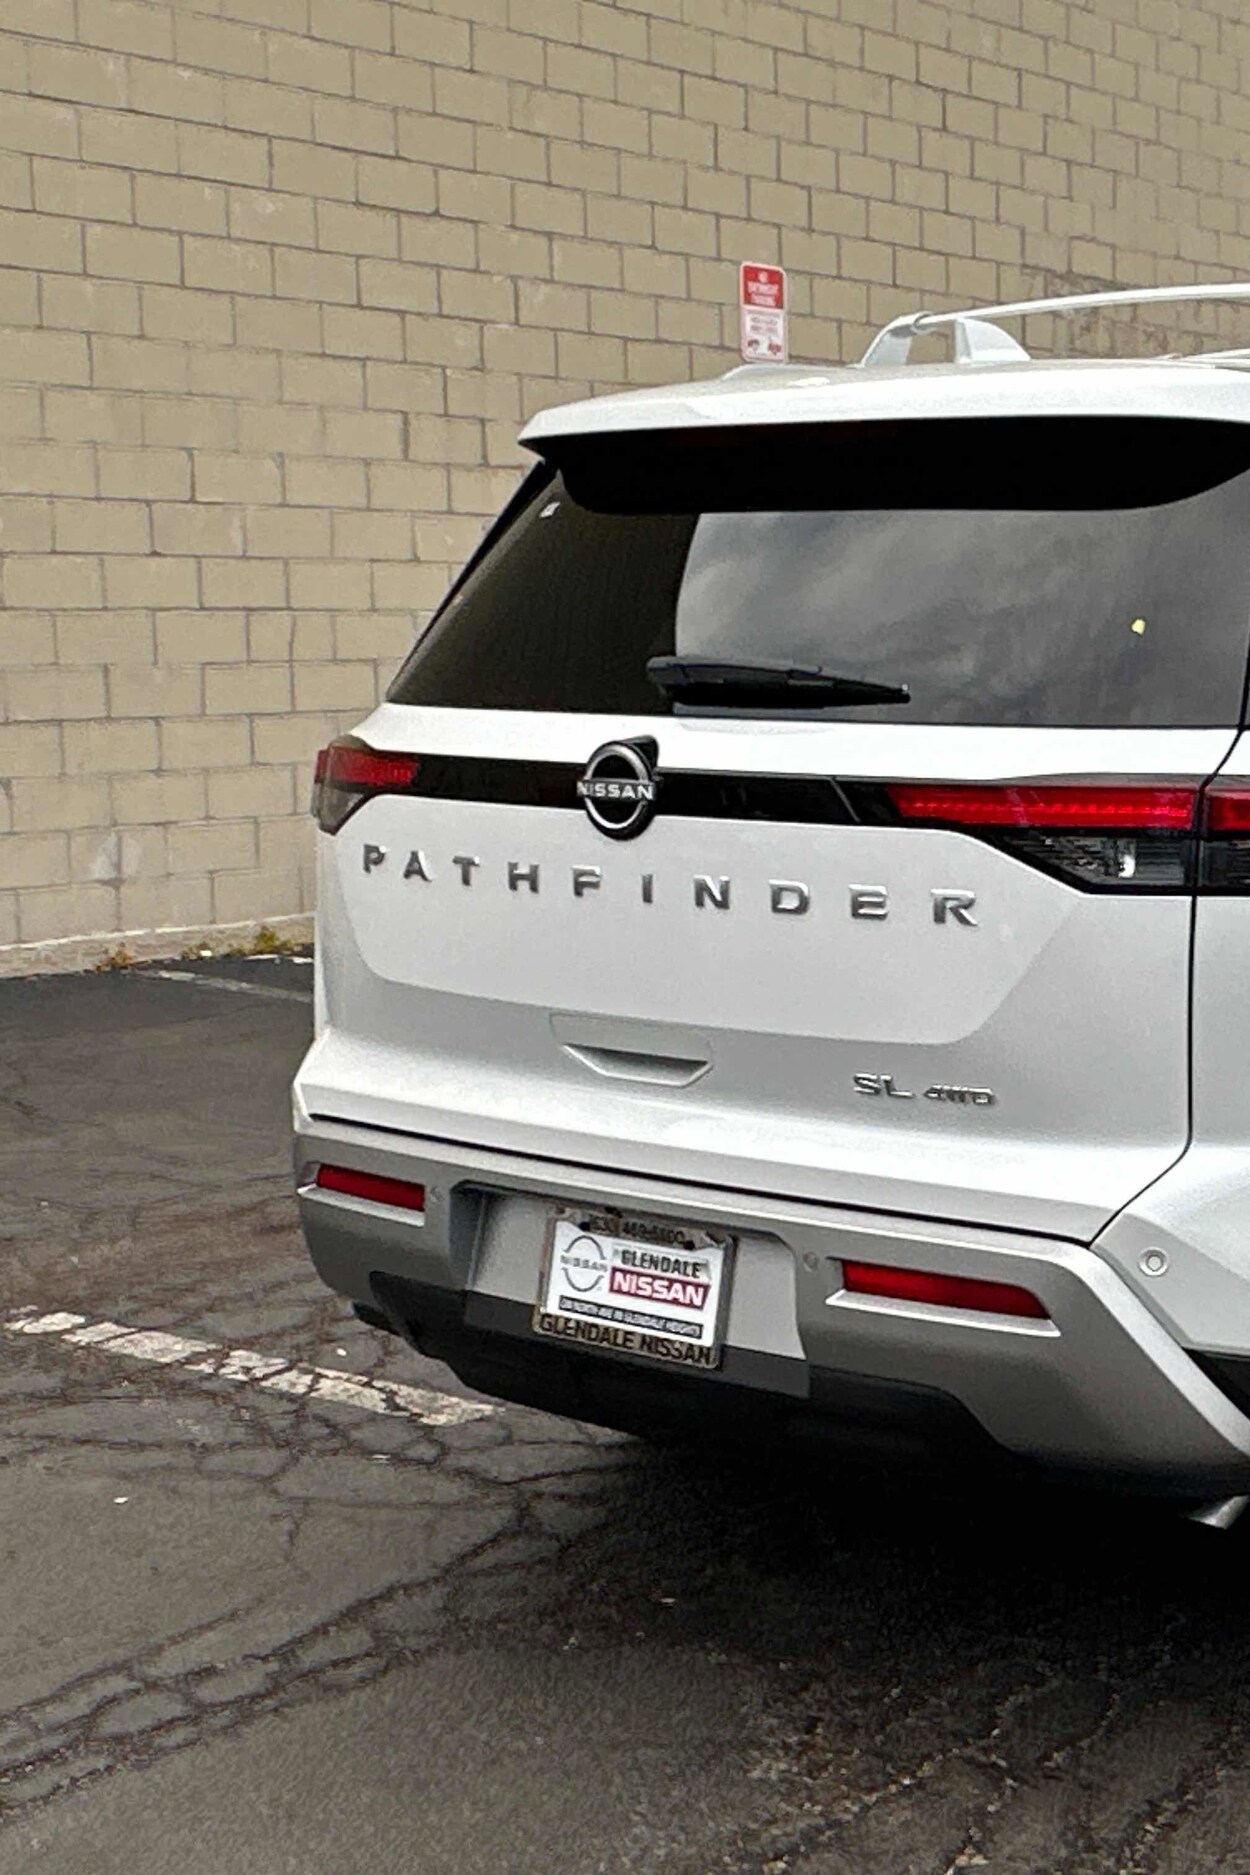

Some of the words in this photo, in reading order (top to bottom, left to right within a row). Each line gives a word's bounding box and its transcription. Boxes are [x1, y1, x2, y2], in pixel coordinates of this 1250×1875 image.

[577, 781, 654, 800] NISSAN
[362, 844, 979, 927] PATHFINDER
[854, 1073, 915, 1098] SL
[924, 1084, 996, 1106] 4WD
[620, 1249, 702, 1279] GLENDALE
[612, 1271, 704, 1307] NISSAN
[540, 1313, 635, 1350] GLENDALE
[638, 1334, 712, 1366] NISSAN
